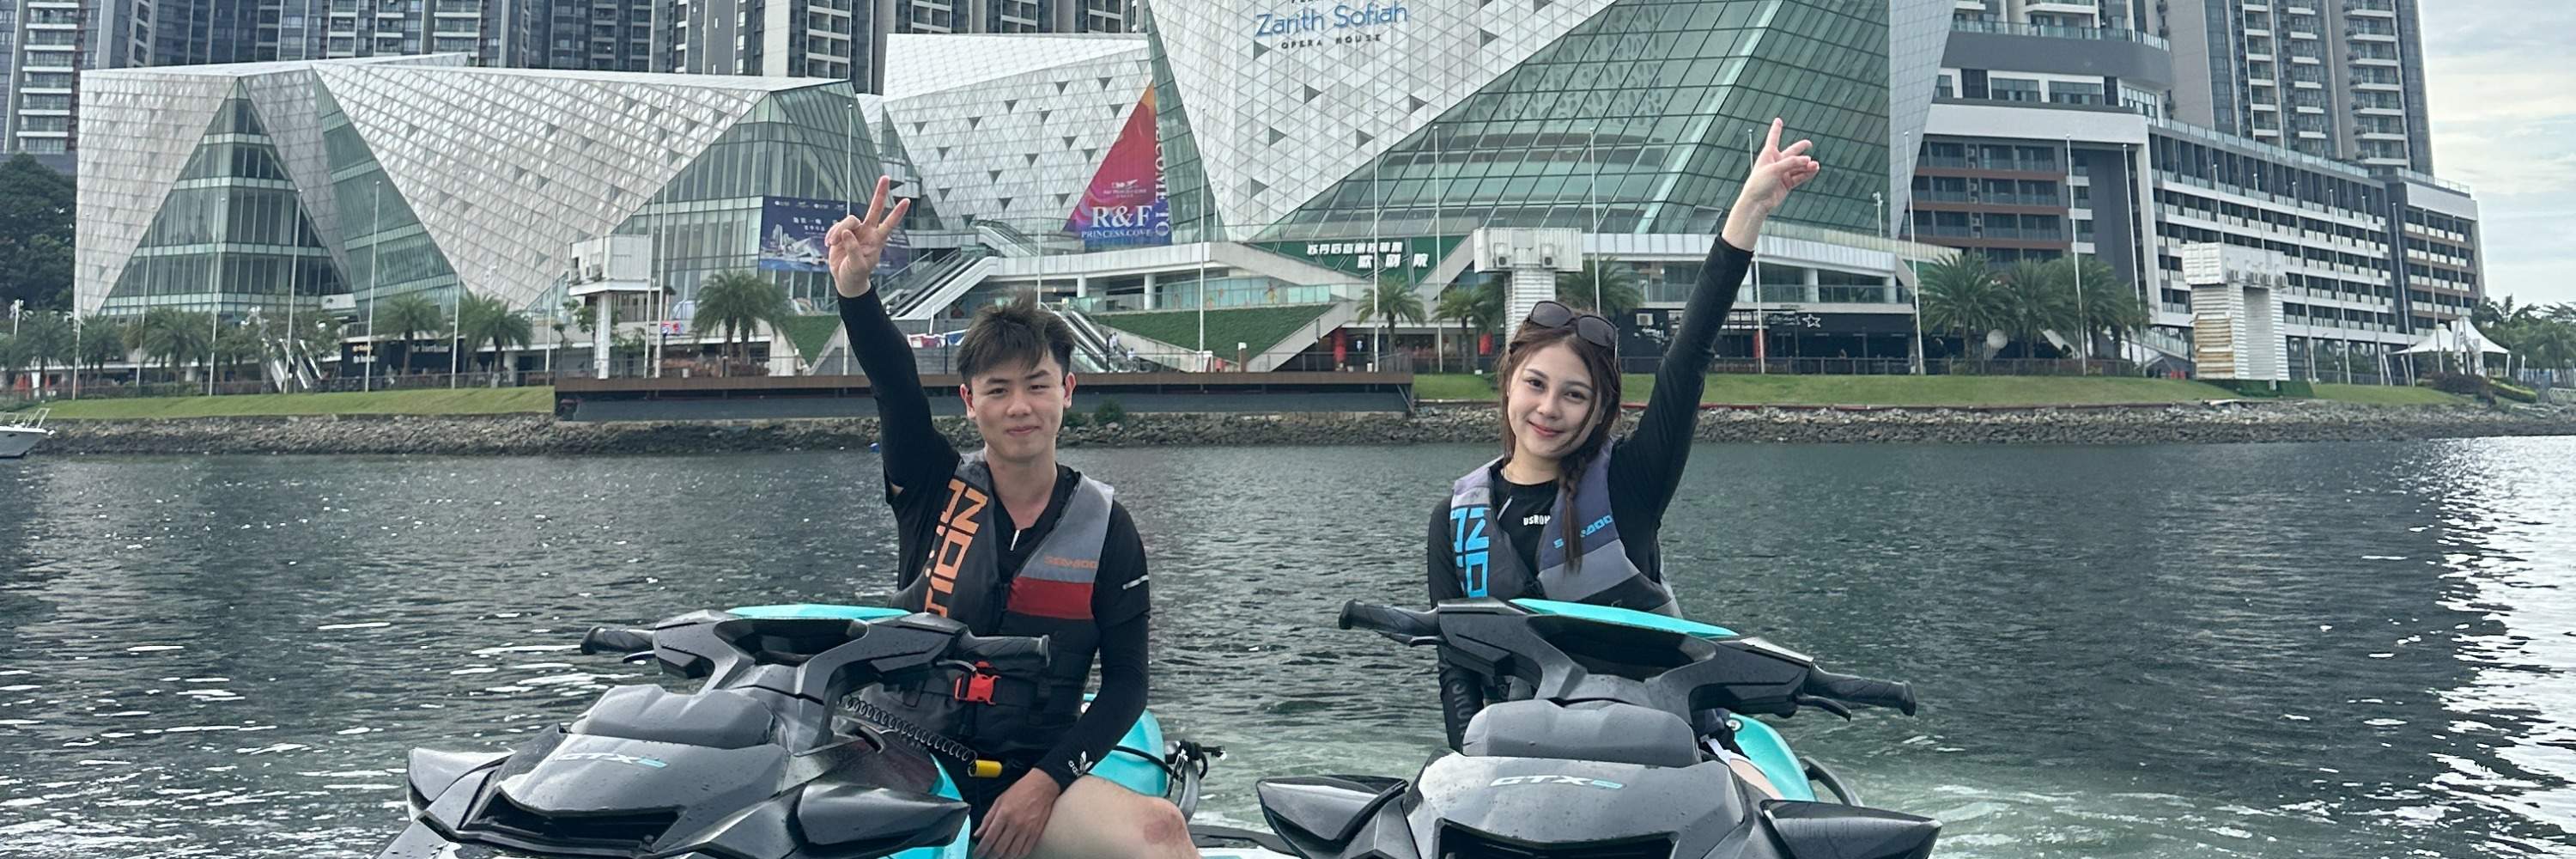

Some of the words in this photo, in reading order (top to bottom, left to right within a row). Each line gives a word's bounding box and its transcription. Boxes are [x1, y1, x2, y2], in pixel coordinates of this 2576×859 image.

[1255, 9, 1325, 37] Zarith
[1333, 1, 1408, 28] Sofiah
[1280, 39, 1323, 50] OPERA
[1335, 34, 1382, 45] HOUSE
[1091, 205, 1152, 228] R&F
[1081, 229, 1124, 239] PRINCESS
[1490, 775, 1592, 786] GTX
